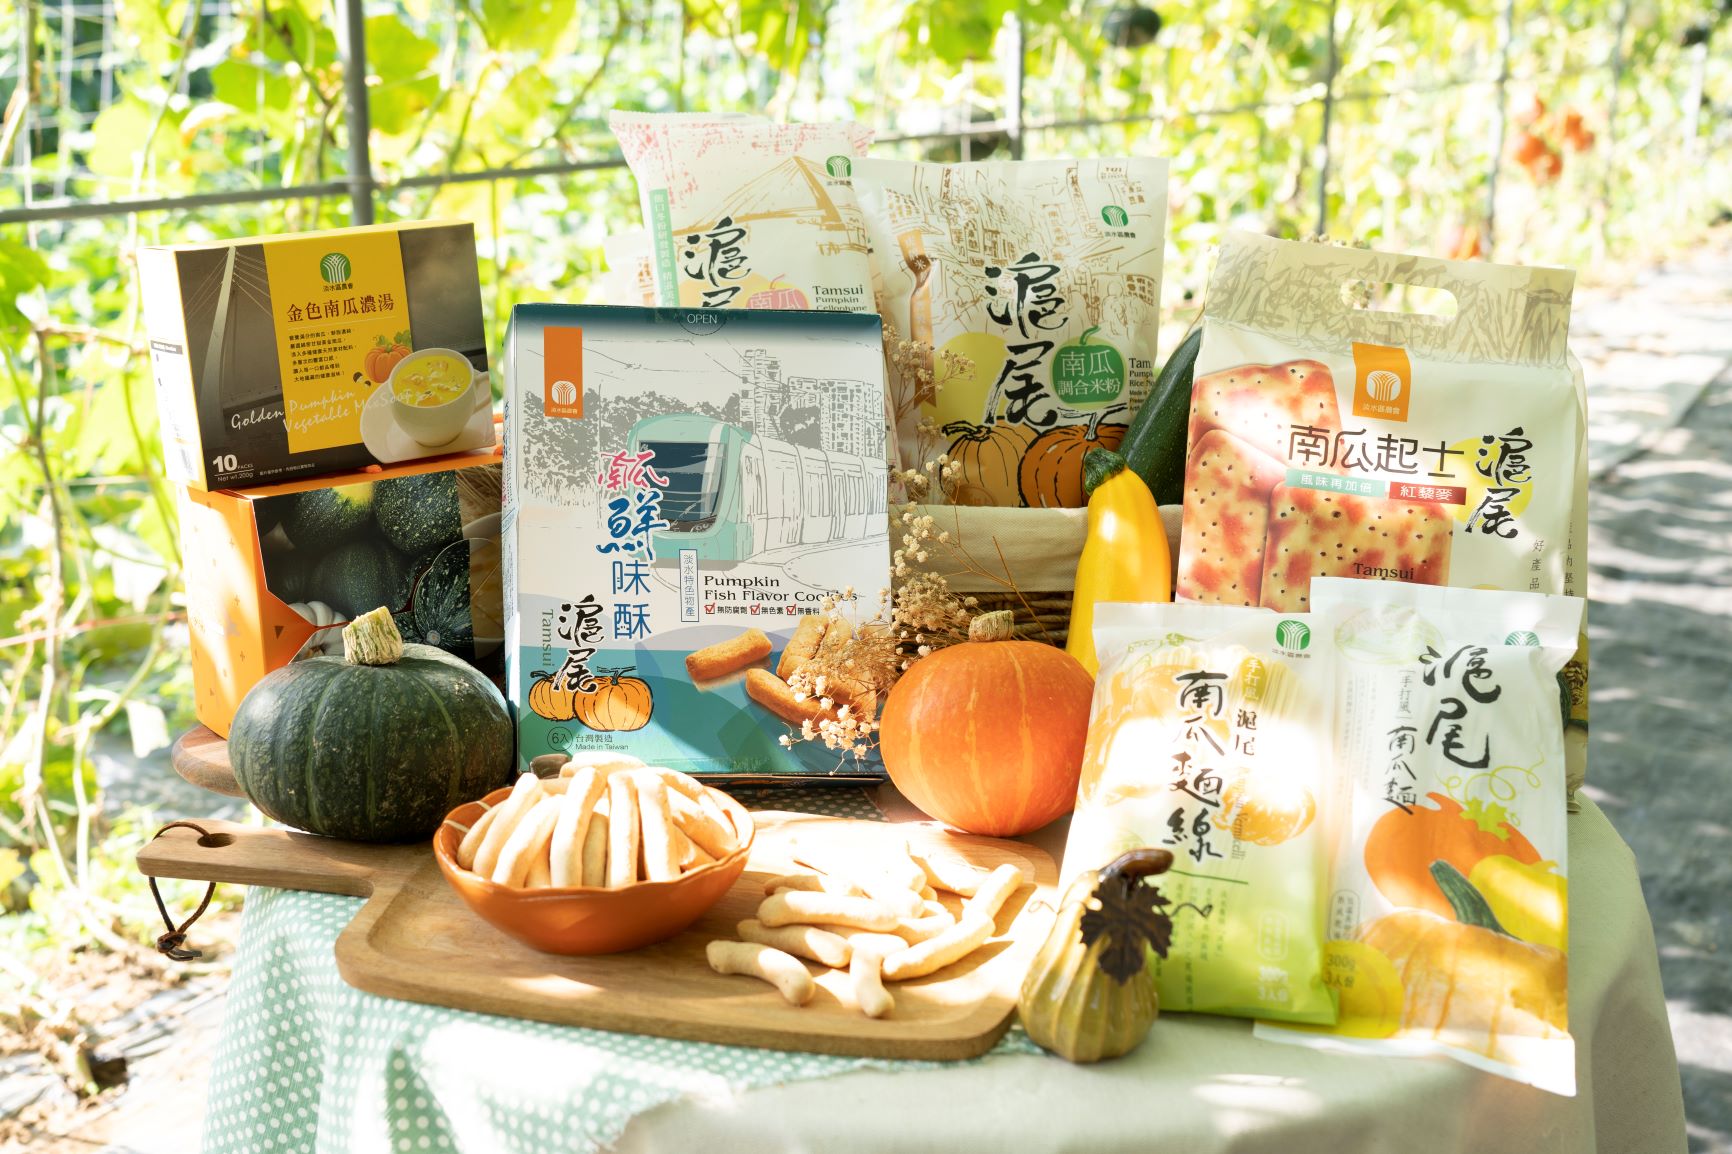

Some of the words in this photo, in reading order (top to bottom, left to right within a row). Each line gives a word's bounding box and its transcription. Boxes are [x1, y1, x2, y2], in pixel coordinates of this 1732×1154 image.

[812, 284, 864, 295] Tamsui
[287, 293, 394, 322] 金色南瓜濃湯
[815, 296, 860, 305] Pumpkin
[687, 313, 718, 324] OPEN
[983, 251, 1069, 427] 滬尾
[1060, 349, 1116, 378] 南瓜
[1058, 377, 1121, 396] 調合米粉
[231, 406, 284, 430] Golden
[289, 389, 356, 414] Pumpkin
[283, 403, 351, 433] Vegetable
[1288, 424, 1465, 479] 南瓜起士
[212, 454, 238, 473] 10
[1301, 474, 1372, 494] 風味再加倍
[1464, 426, 1533, 539] 滬尾
[1400, 485, 1453, 501] 紅藜麥
[1353, 562, 1414, 580] Tamsui
[1529, 539, 1545, 590] 好產品
[683, 554, 695, 617] 淡水特色物產
[704, 576, 780, 588] Pumpkin
[704, 590, 736, 600] Fish
[742, 590, 790, 601] Flavor
[717, 605, 748, 615] 無防腐劑
[761, 606, 784, 615] 無色素
[797, 607, 820, 616] 無香料
[542, 608, 555, 667] Tamsui
[553, 593, 604, 693] 滬尾
[1418, 644, 1502, 769] 滬尾
[552, 732, 570, 744] 6入
[575, 734, 613, 743] 台灣製造
